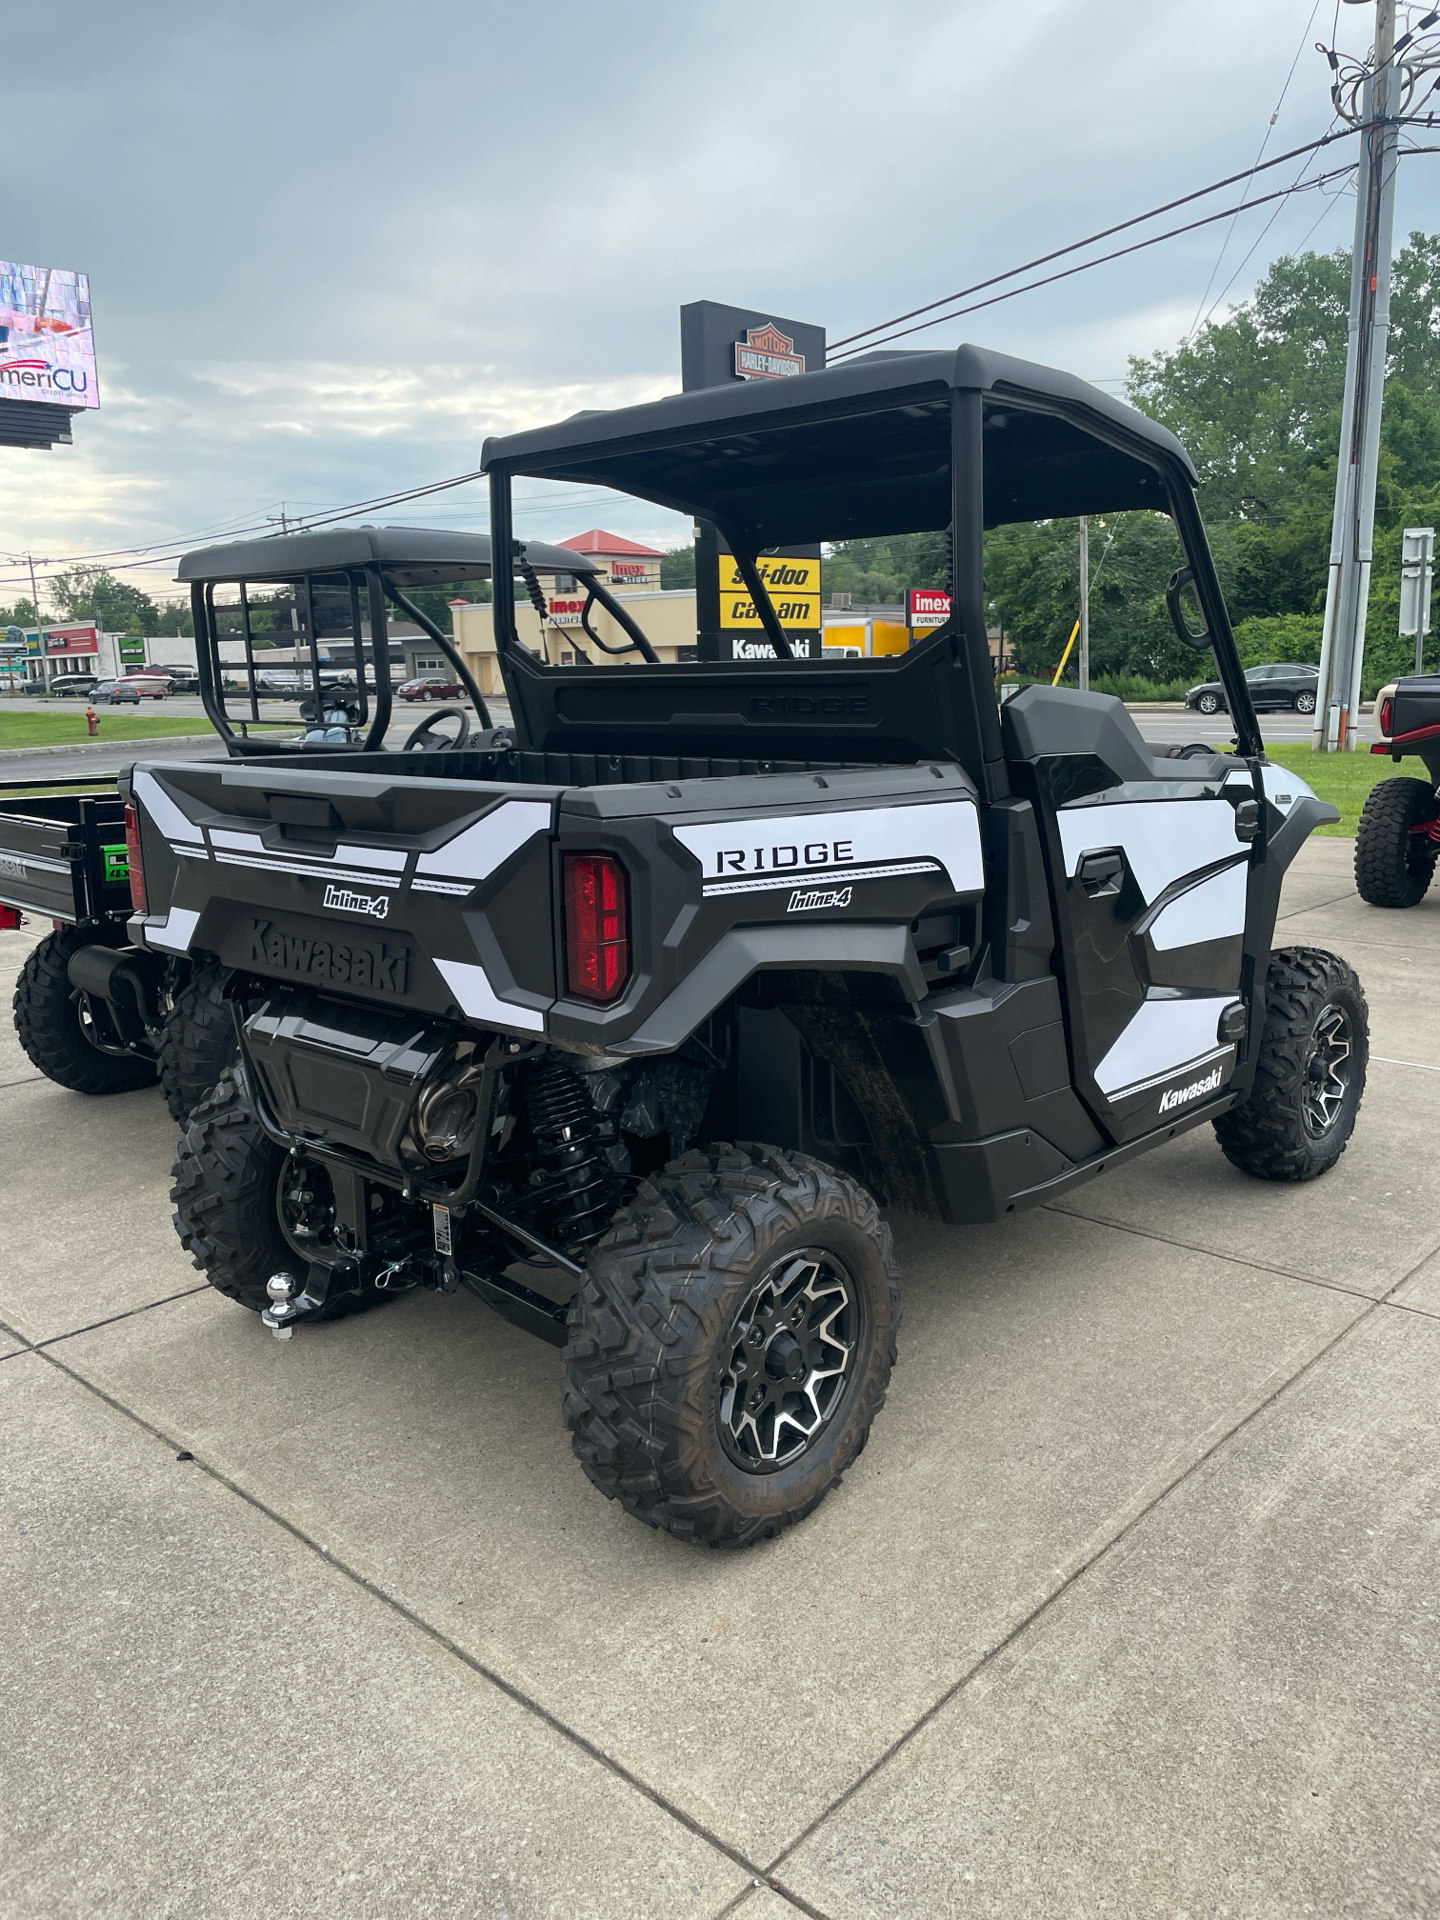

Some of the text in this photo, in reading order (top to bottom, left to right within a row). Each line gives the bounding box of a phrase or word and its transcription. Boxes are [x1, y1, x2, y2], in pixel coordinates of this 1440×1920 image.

[755, 334, 786, 354] MOTOR
[740, 350, 800, 376] HARLEY-DAVIDSON
[612, 560, 645, 576] imex
[731, 564, 809, 585] si-doo
[548, 597, 586, 614] imex
[731, 601, 810, 620] caam
[915, 593, 951, 611] imex
[732, 639, 810, 659] Kawaki
[749, 696, 869, 713] RIDGE
[716, 840, 854, 874] RIDGE
[250, 918, 411, 995] Kawasaki
[1158, 1065, 1222, 1114] Kawasaki
